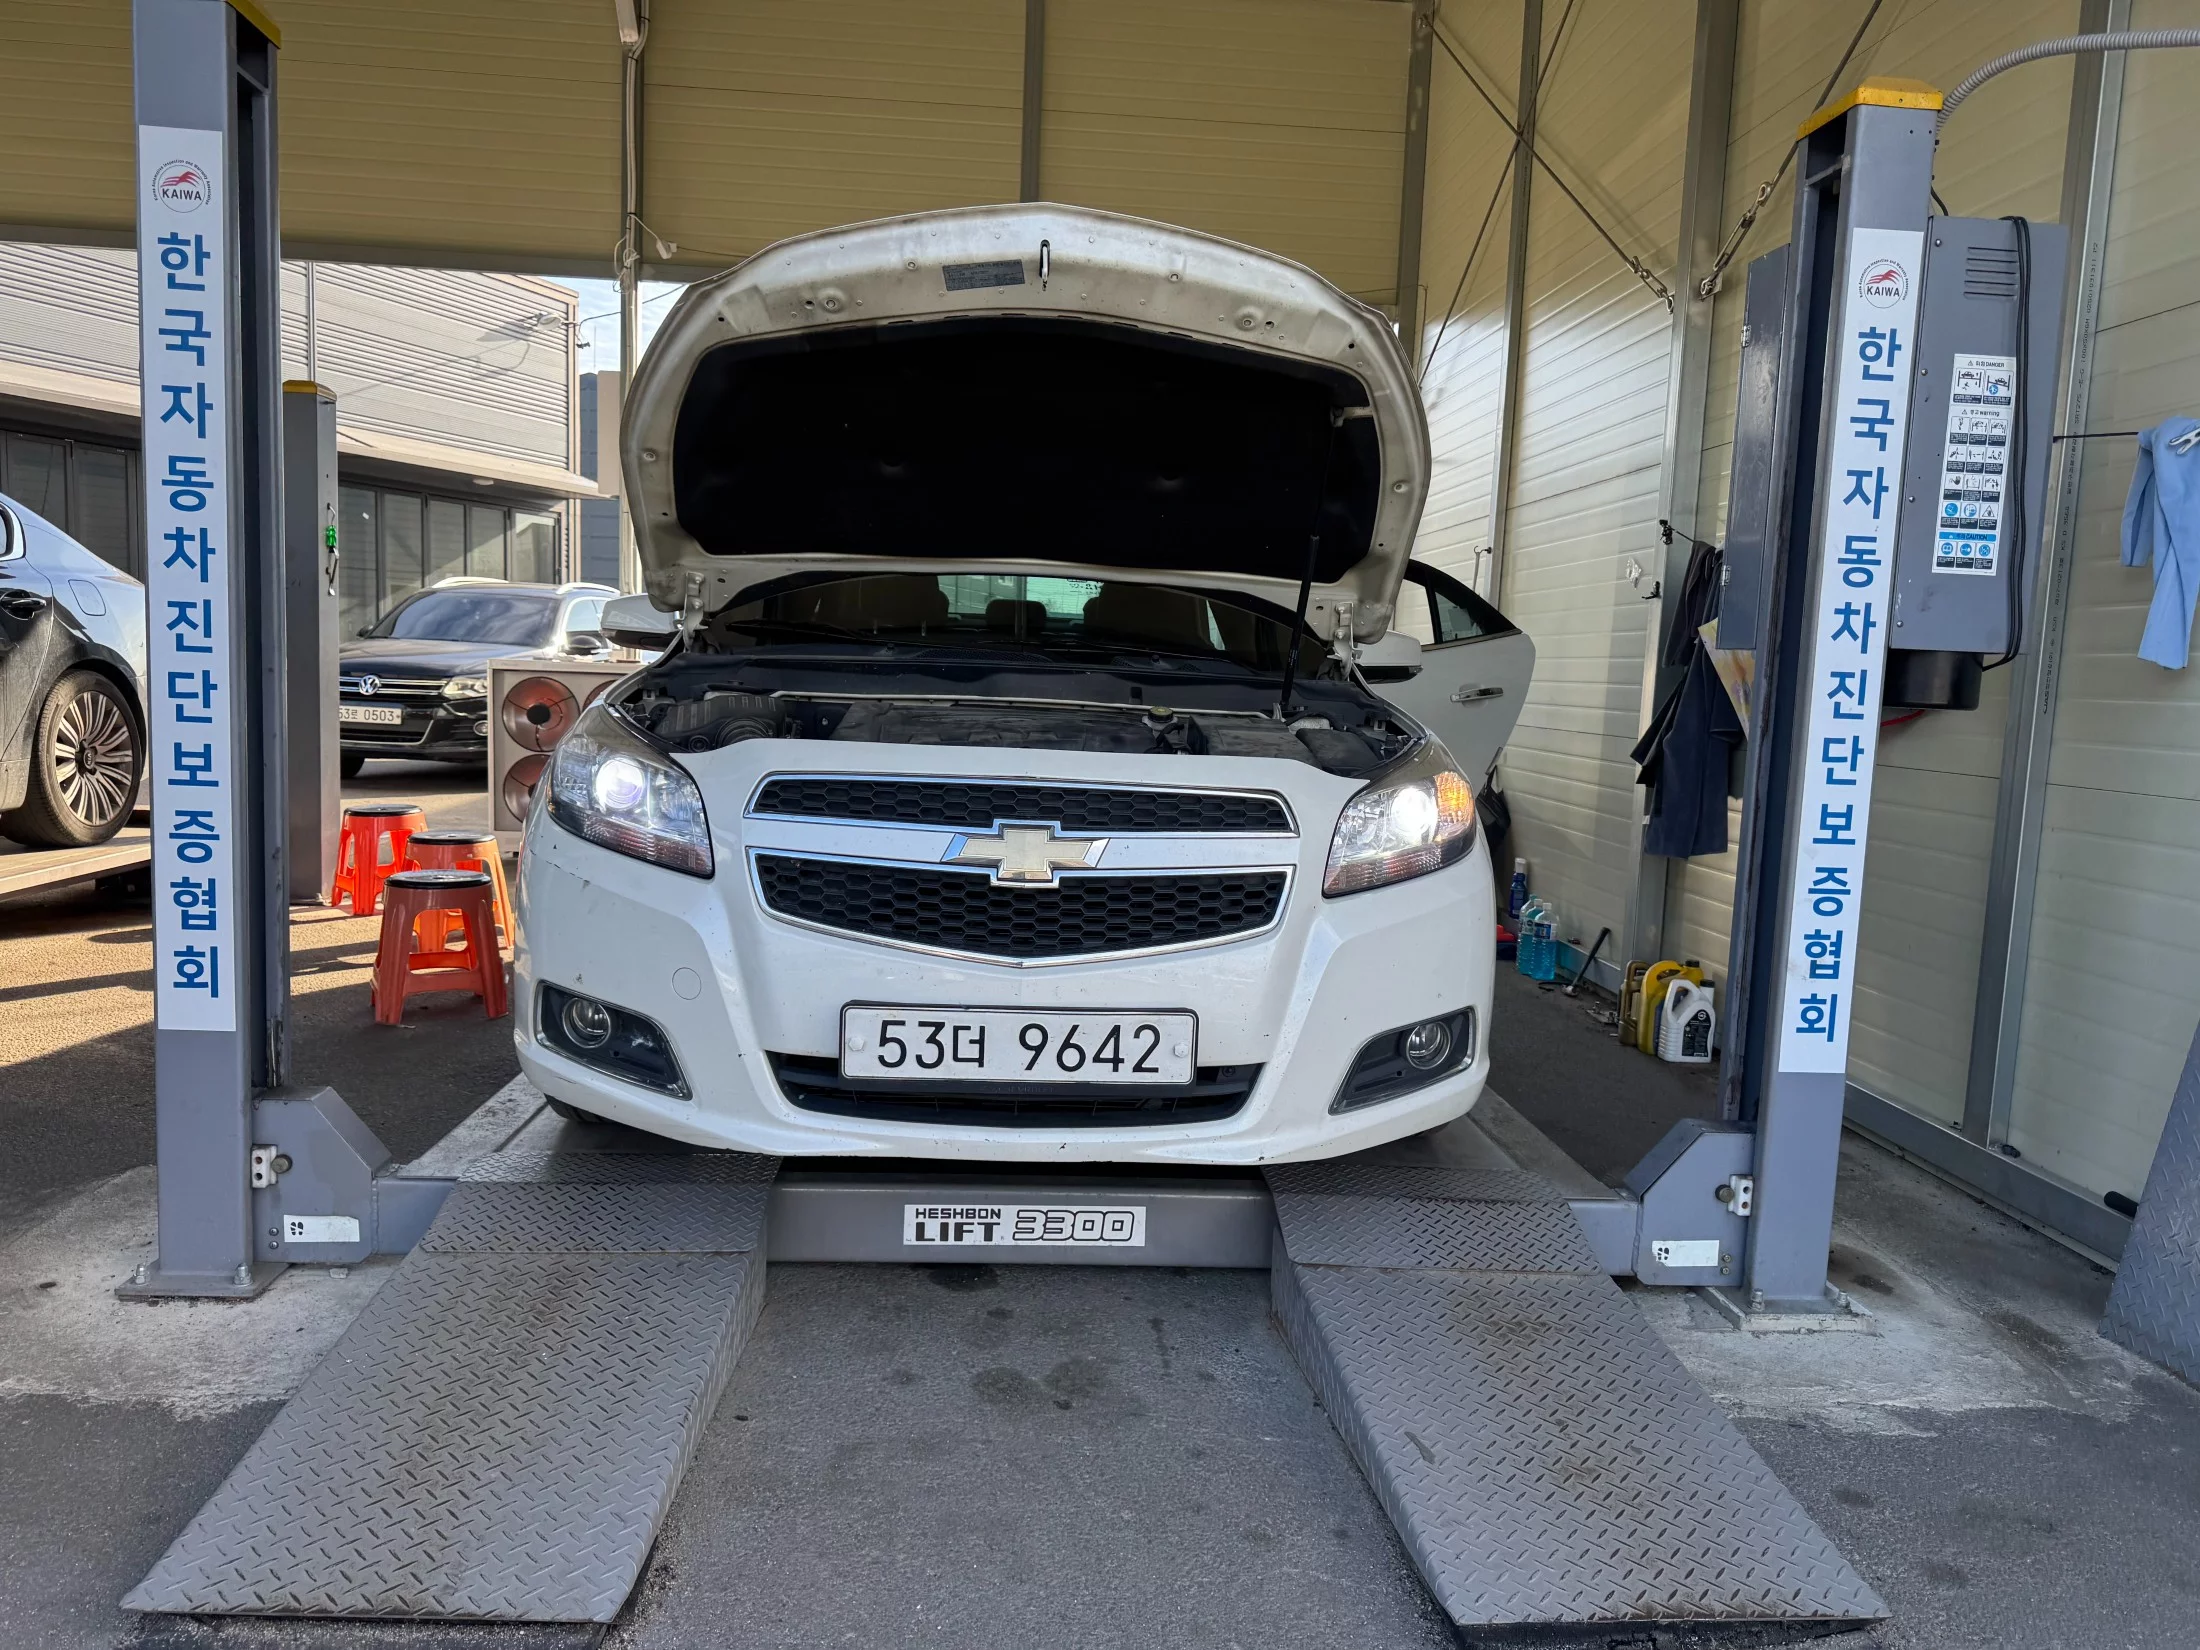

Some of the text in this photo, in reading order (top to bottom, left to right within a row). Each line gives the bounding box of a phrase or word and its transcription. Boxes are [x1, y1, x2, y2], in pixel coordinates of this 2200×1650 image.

[162, 188, 202, 201] KAIWA
[1866, 285, 1900, 297] KAIWA
[1966, 533, 1988, 541] CAUTION
[157, 231, 220, 998] 한국자동차진단보증협회
[1796, 327, 1902, 1042] 한국자동차진단보증협회
[363, 709, 395, 722] 0503
[877, 1019, 1161, 1074] 53더 9642
[915, 1207, 1002, 1220] HESHBON
[915, 1209, 1135, 1242] LIFT 3300
